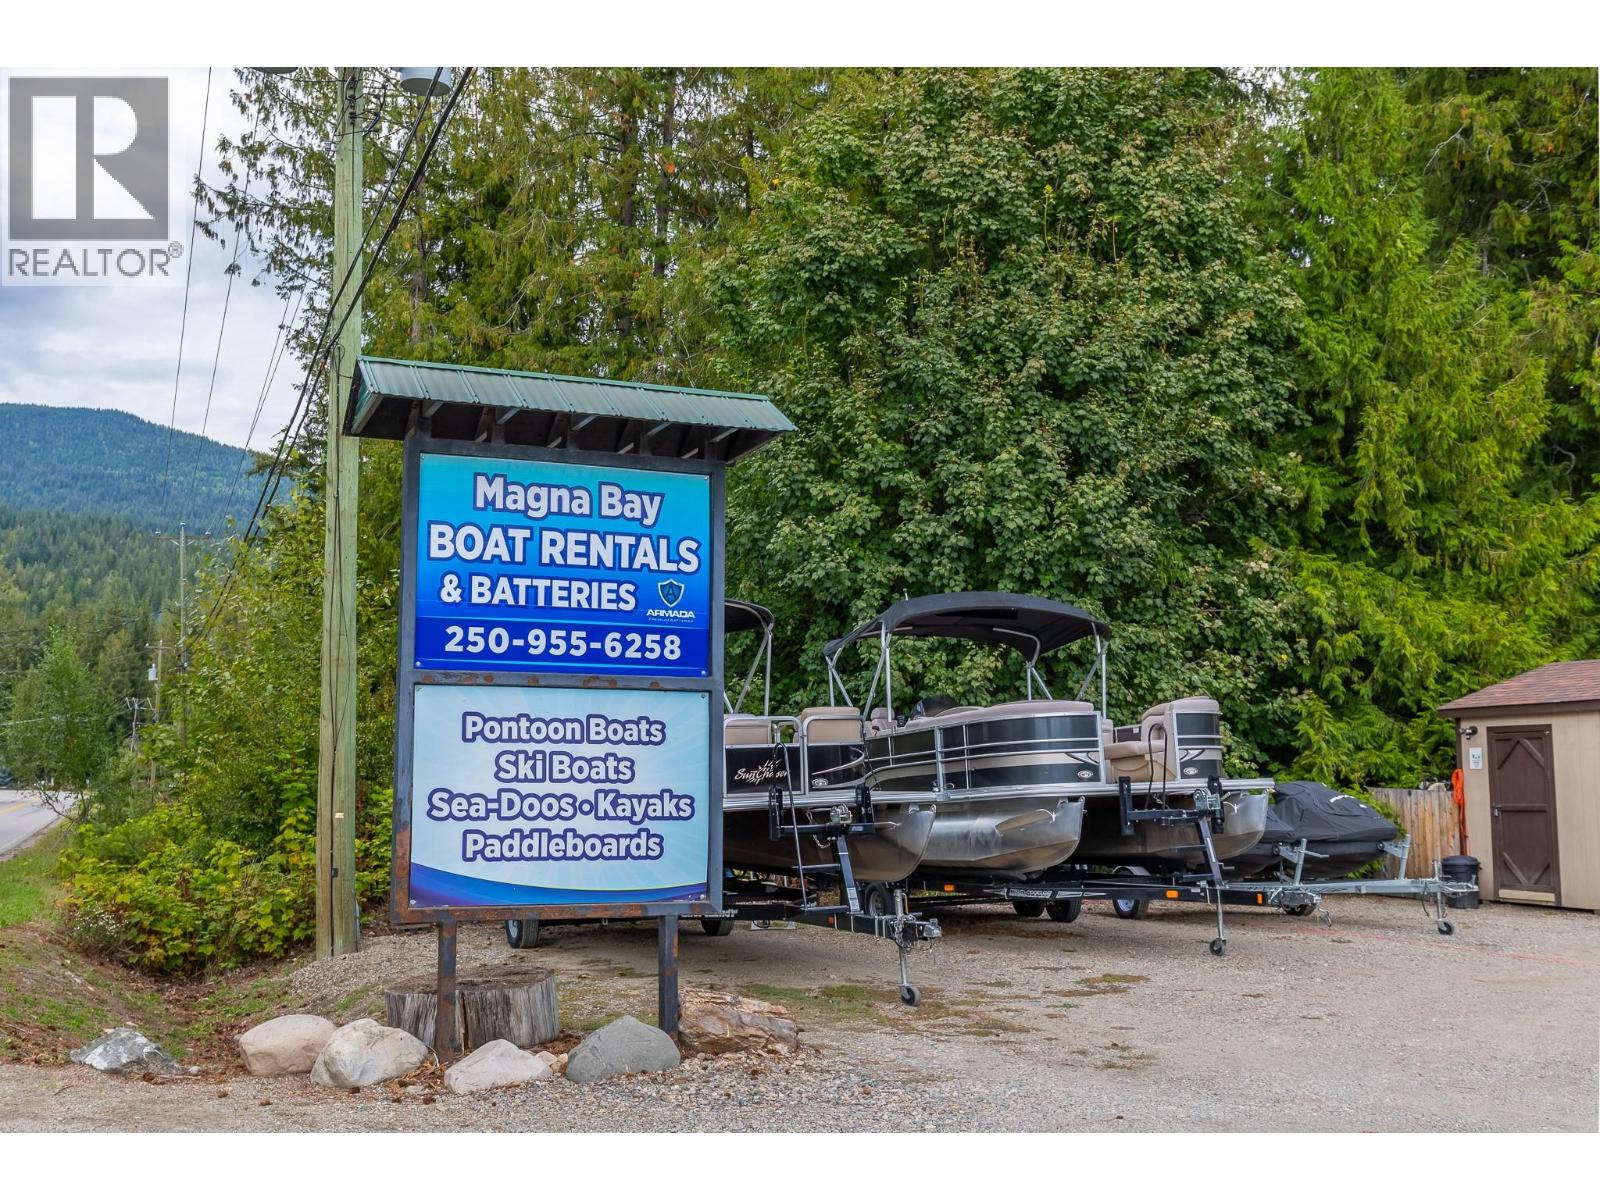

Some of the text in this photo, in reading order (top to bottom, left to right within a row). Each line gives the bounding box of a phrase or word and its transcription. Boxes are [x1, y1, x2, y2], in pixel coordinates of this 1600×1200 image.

[475, 474, 663, 527] Magna Bay
[429, 523, 700, 574] BOAT RENTALS
[439, 573, 637, 612] & BATTERIES
[647, 609, 695, 618] ARMADA
[444, 625, 682, 660] 250-955-6258
[464, 713, 664, 744] Pontoon Boats
[497, 752, 633, 783] Ski Boats
[430, 791, 693, 823] Sea-Doos Kayaks
[464, 831, 662, 860] Paddleboards
